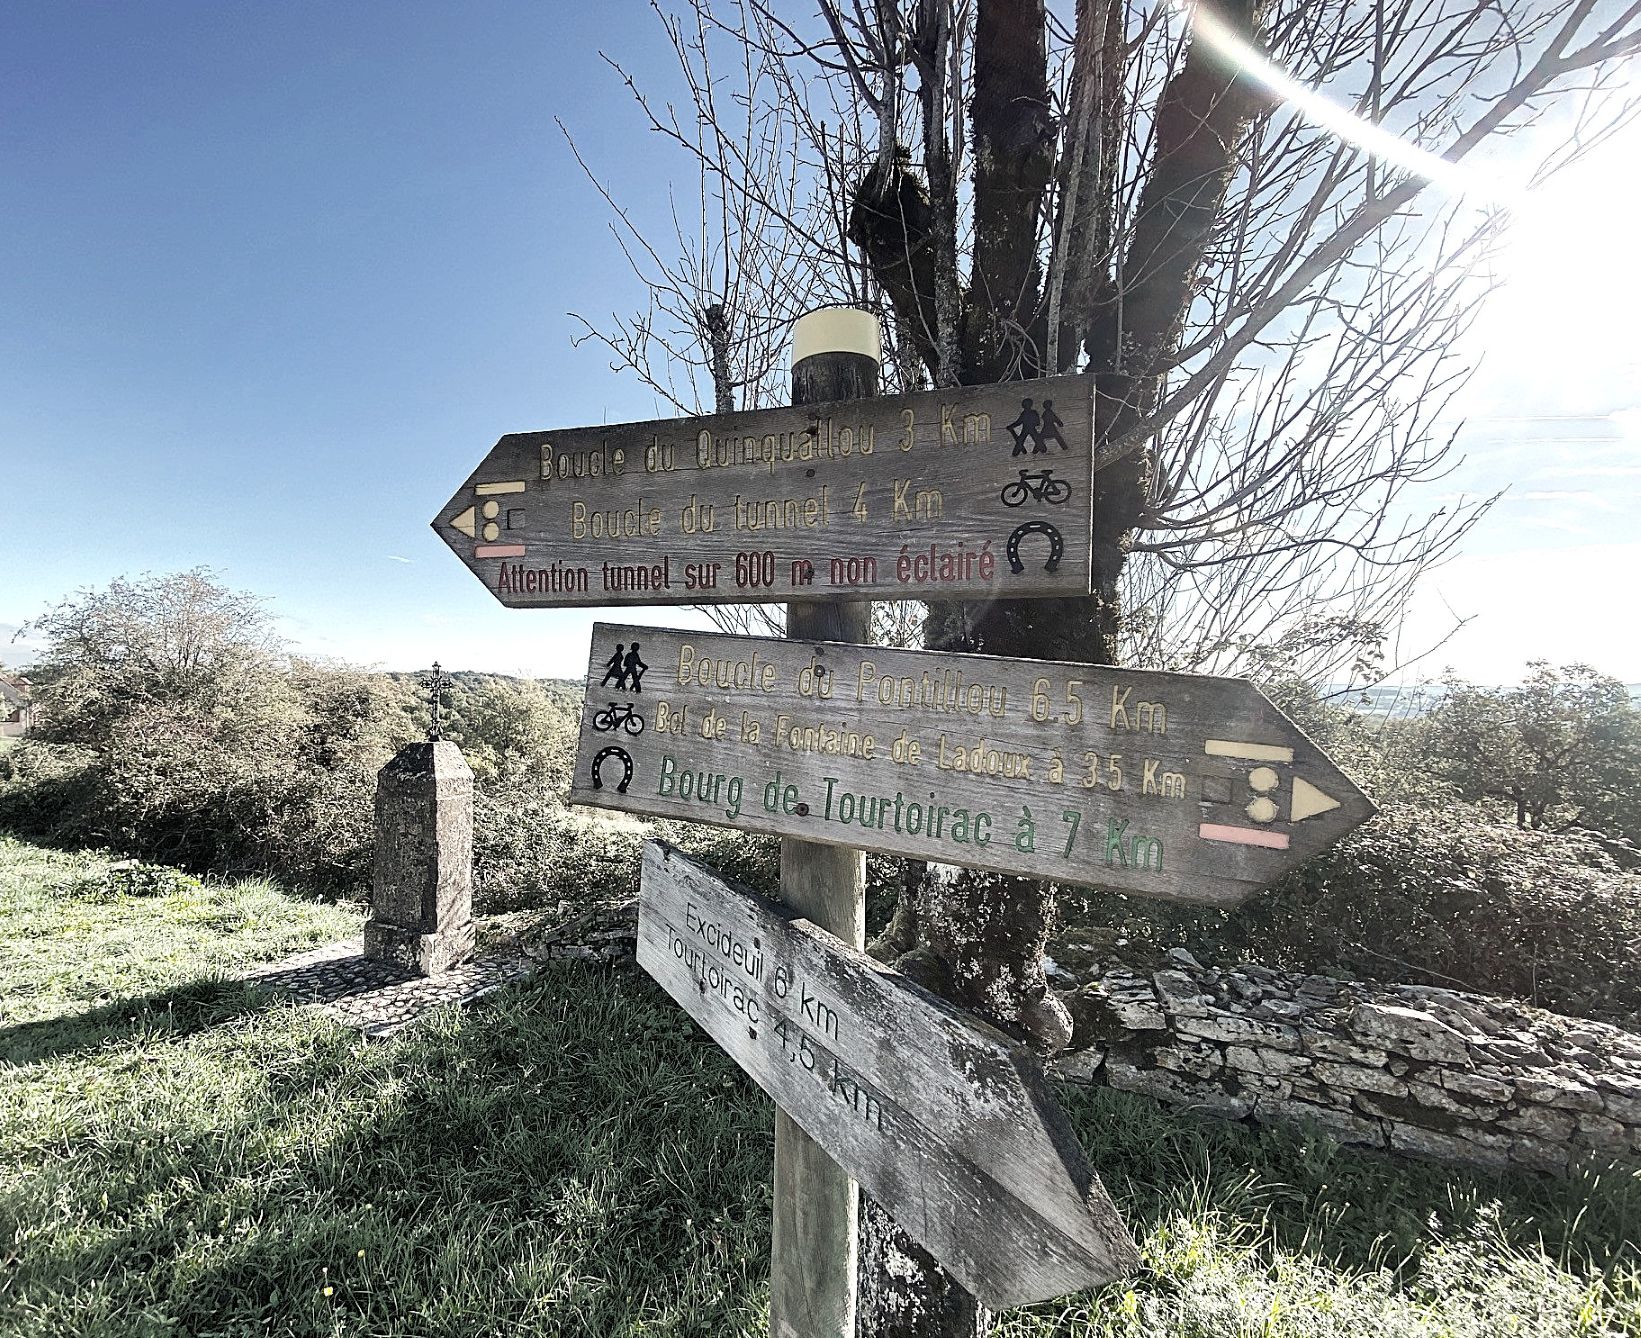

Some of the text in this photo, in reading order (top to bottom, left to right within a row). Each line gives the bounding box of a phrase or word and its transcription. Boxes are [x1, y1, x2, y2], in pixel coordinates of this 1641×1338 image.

[538, 442, 625, 480] Boucle
[644, 435, 676, 472] du
[898, 408, 915, 452] 3
[939, 402, 992, 446] Km
[571, 478, 944, 540] Boucle du tunnel 4 Km
[498, 540, 995, 594] Attention tunnel sur 600 m non éclairé
[677, 644, 777, 693] Boucle
[798, 657, 834, 700] du
[857, 660, 1007, 717] Pontillou
[1110, 683, 1168, 735] Km
[701, 705, 727, 740] de
[740, 711, 760, 746] la
[775, 714, 876, 760] Fontaine
[891, 730, 921, 767] de
[938, 734, 1031, 780] Ladoux
[1048, 746, 1064, 784] à
[1142, 758, 1187, 799] Km
[659, 755, 1164, 873] Bourg de Tourtoirac à 7 Km
[685, 902, 839, 1041] Excideuil 6 km
[665, 923, 882, 1131] Tourtoirac 4,5 km
